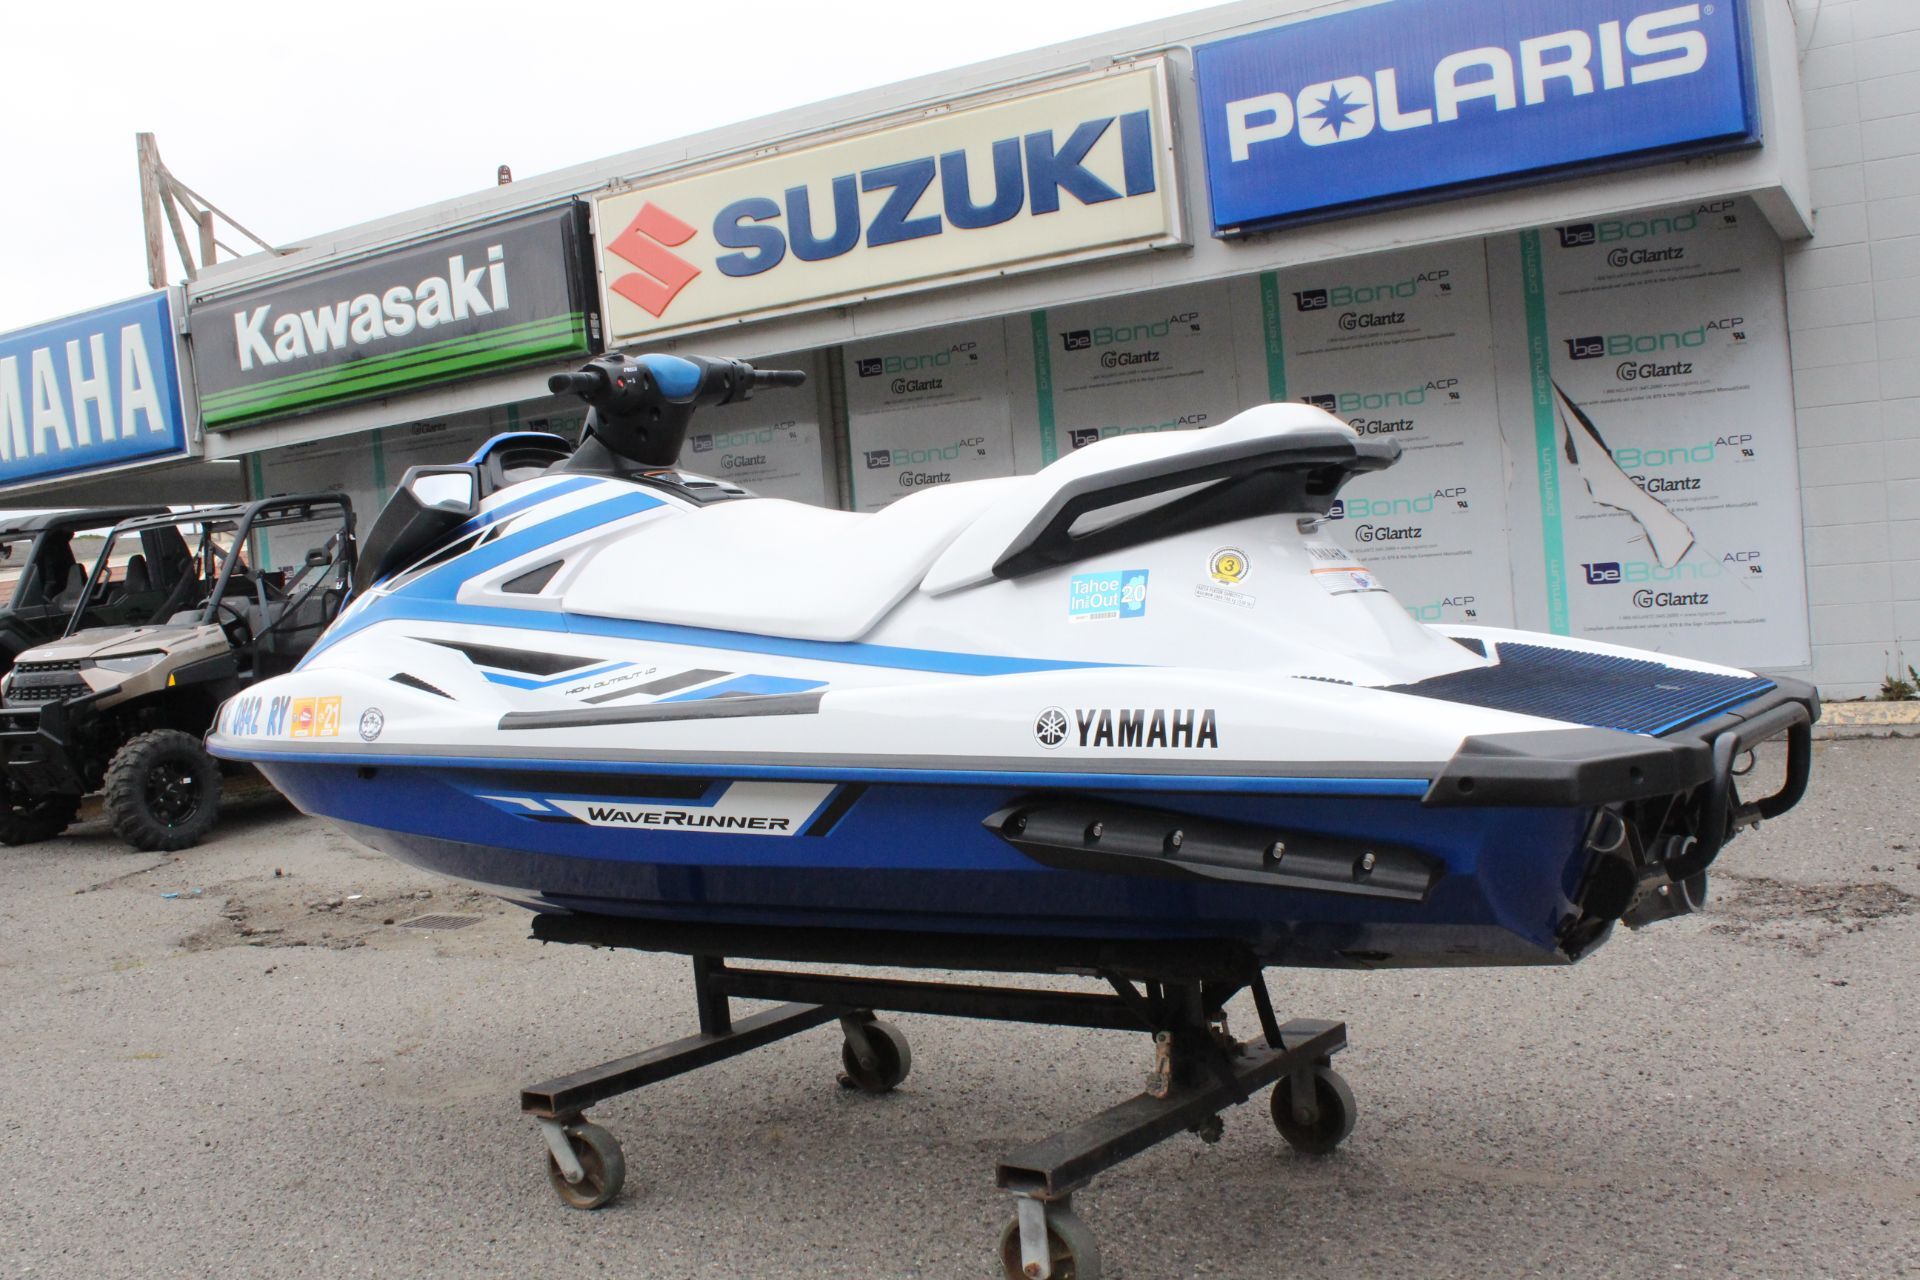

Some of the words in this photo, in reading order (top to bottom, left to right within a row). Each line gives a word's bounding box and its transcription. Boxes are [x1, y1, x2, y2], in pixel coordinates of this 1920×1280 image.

[1226, 4, 1707, 162] POLARIS
[713, 109, 1155, 277] SUZUKI
[1698, 200, 1735, 214] ACP
[1417, 270, 1449, 282] ACP
[234, 244, 510, 371] Kawasaki
[1169, 312, 1199, 324] ACP
[1707, 317, 1744, 330] ACP
[951, 342, 977, 352] ACP
[1425, 379, 1458, 391] ACP
[1178, 414, 1207, 425] ACP
[959, 437, 985, 448] ACP
[1714, 434, 1752, 447] ACP
[1647, 477, 1701, 492] Glantz
[1434, 487, 1466, 498] ACP
[1723, 551, 1760, 562] ACP
[1224, 560, 1235, 572] 3
[1072, 579, 1119, 595] Tahoe
[1121, 584, 1147, 604] 20
[1089, 592, 1119, 609] Out
[1442, 596, 1475, 607] ACP
[266, 695, 291, 736] RY
[324, 704, 339, 731] 21
[1075, 709, 1218, 748] YAMAHA
